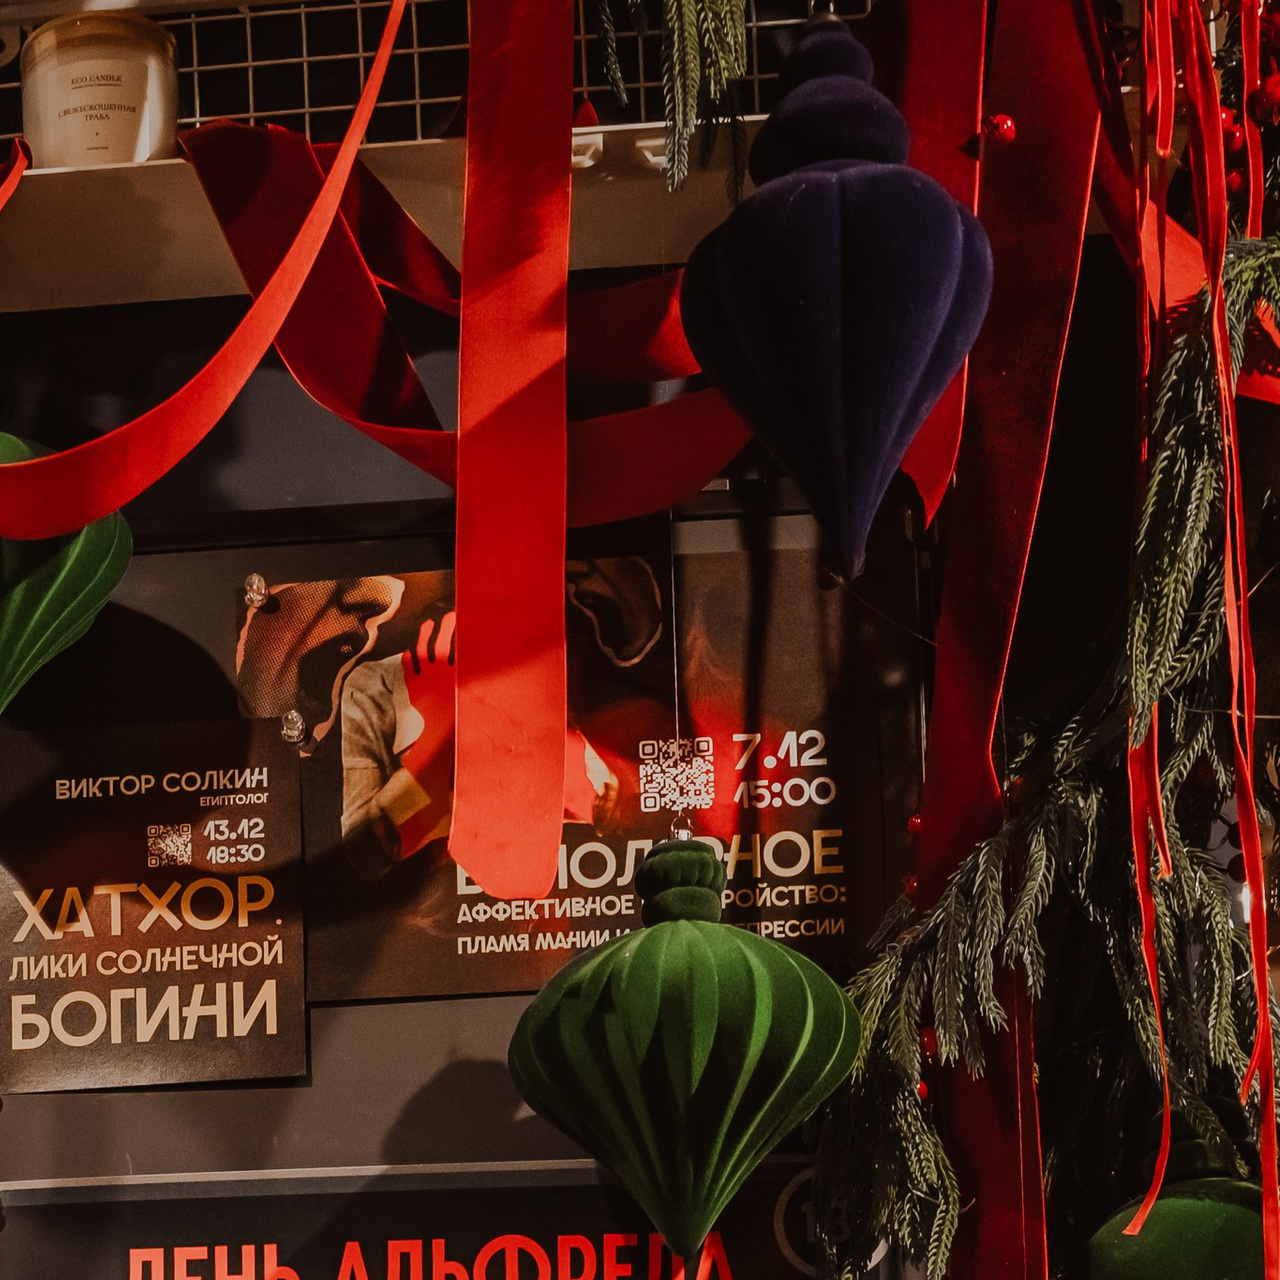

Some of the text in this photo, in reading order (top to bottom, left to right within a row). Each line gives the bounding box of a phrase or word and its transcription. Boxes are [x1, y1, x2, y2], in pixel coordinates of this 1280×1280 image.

[85, 113, 110, 121] ТРАВА
[732, 729, 828, 771] 7.12
[55, 766, 269, 800] ВИКТОР СОЛКИН
[732, 776, 836, 810] 15:00
[200, 792, 269, 807] ЕГИПТОЛОГ
[203, 817, 265, 842] 13.12
[207, 843, 265, 865] 18:30
[457, 894, 635, 924] АФФЕКТИВНОЕ
[458, 934, 530, 955] ПЛАМЯ
[535, 929, 610, 951] МАНИИ
[10, 935, 283, 982] ЛИКИ СОЛНЕЧНОЙ
[11, 979, 278, 1051] БОГИНИ
